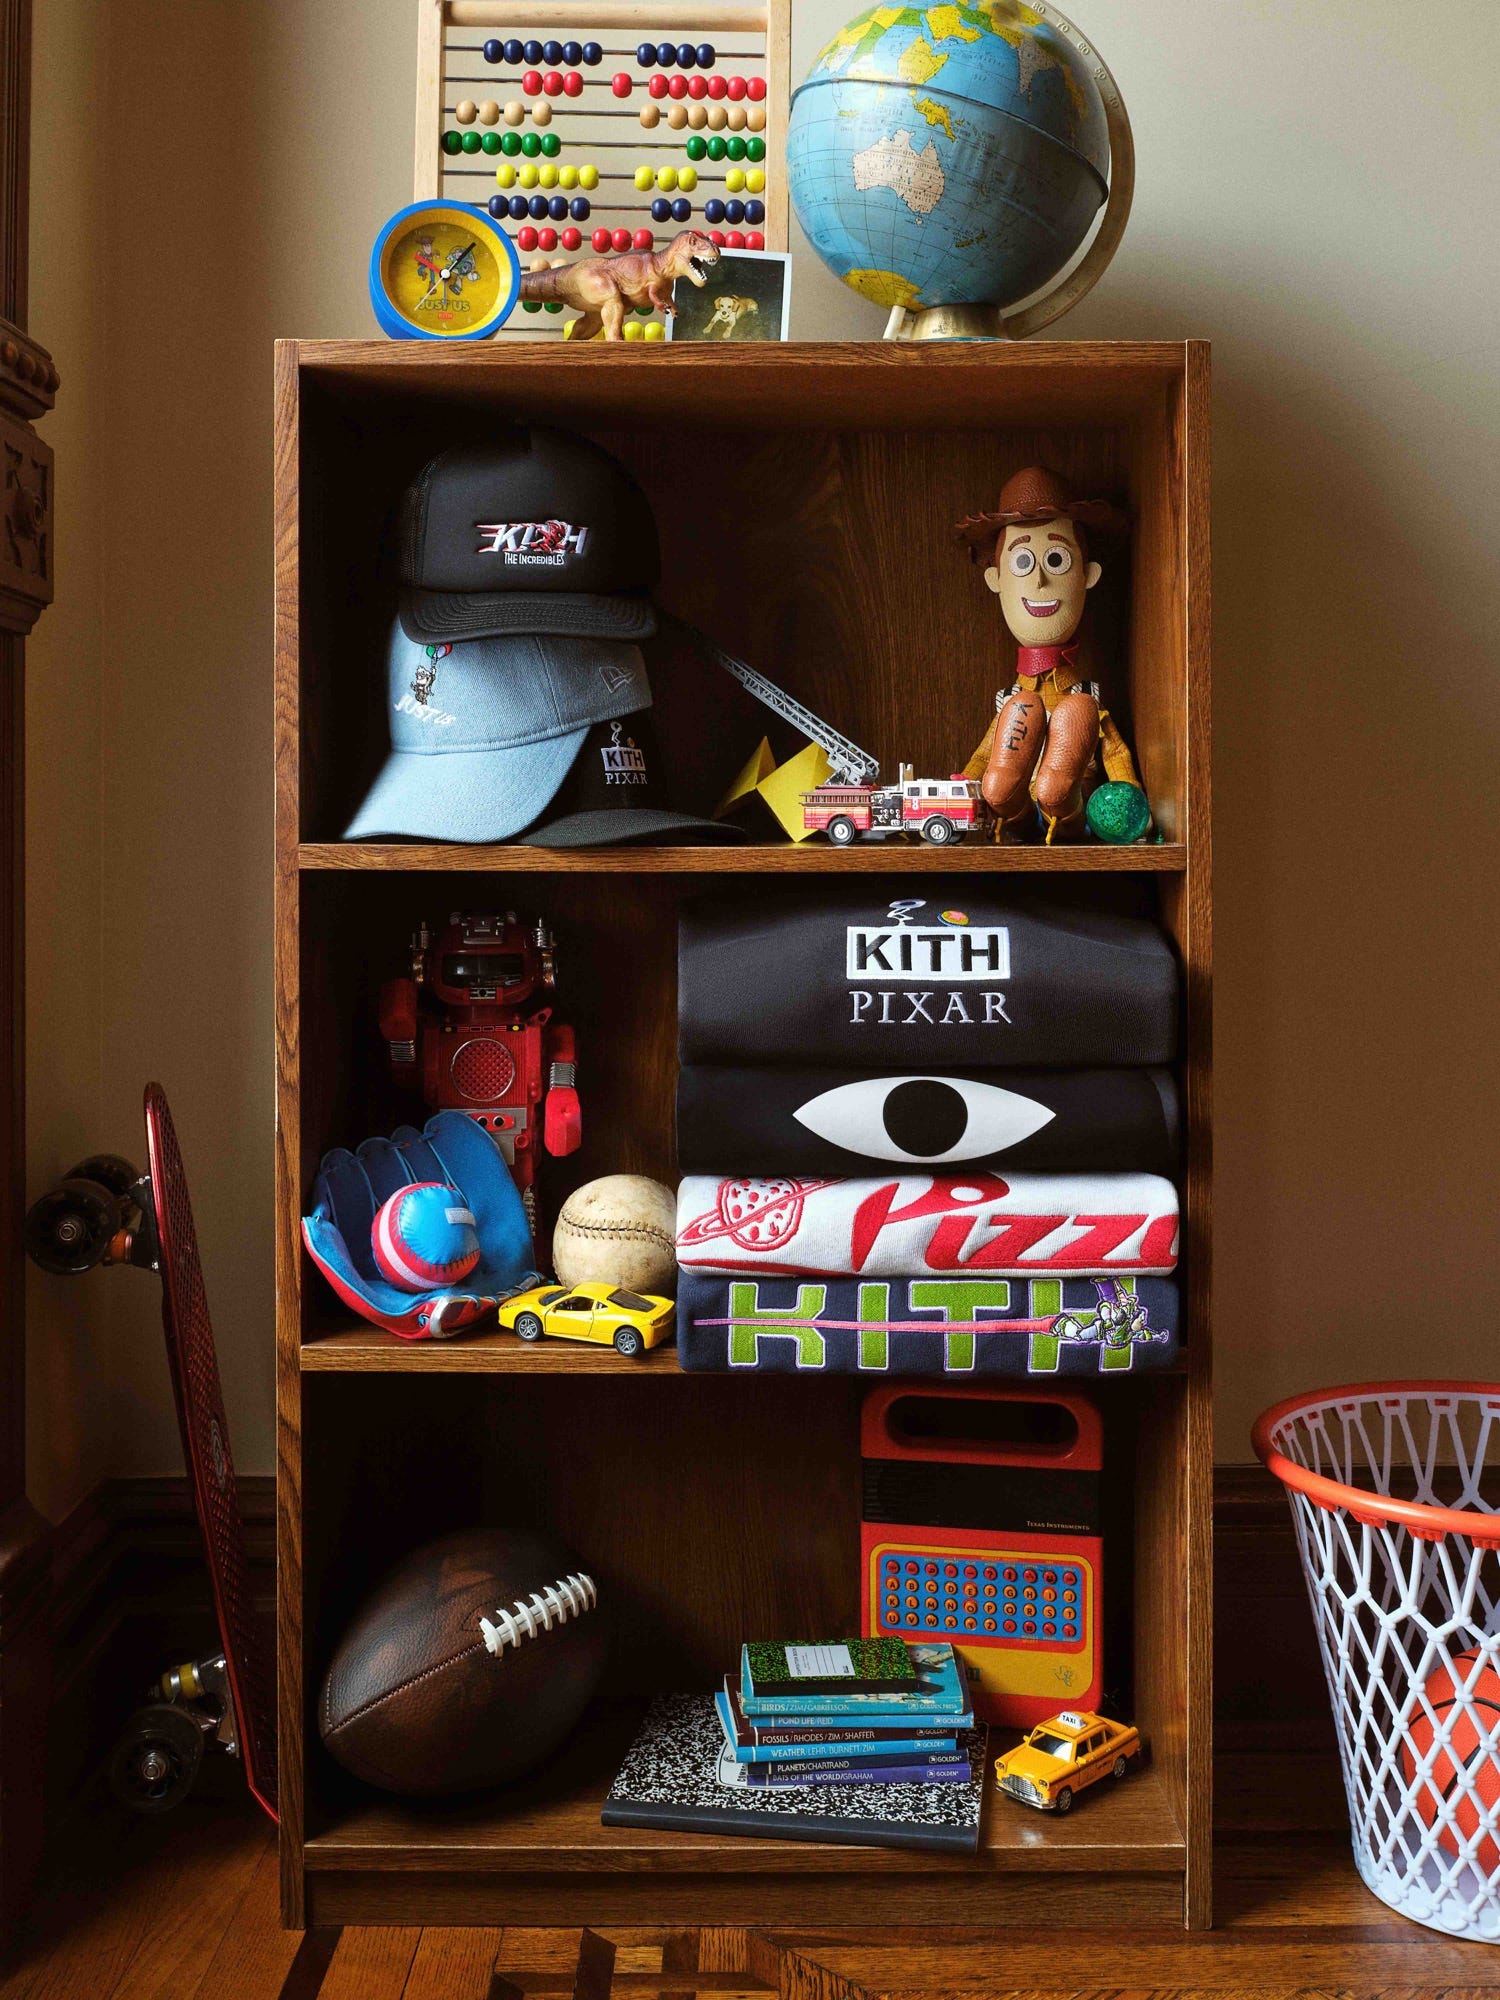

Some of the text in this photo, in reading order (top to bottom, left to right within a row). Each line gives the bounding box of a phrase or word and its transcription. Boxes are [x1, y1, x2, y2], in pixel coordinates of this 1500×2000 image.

[1032, 2, 1046, 14] 80
[1056, 19, 1070, 33] 70
[1078, 42, 1090, 56] 60
[1094, 67, 1107, 80] 50
[451, 299, 470, 312] US
[480, 522, 588, 554] KIH
[504, 552, 565, 565] THE INCREDIBLES
[393, 692, 456, 725] JUST US
[1006, 702, 1034, 750] KITH
[605, 750, 643, 768] KITH
[605, 772, 648, 785] PIXAR
[912, 798, 919, 810] 8
[857, 934, 1000, 971] KITH
[848, 990, 1012, 1024] PIXAR
[728, 1278, 1139, 1372] KITH
[778, 1716, 800, 1725] POND
[1062, 1714, 1076, 1724] TAXI
